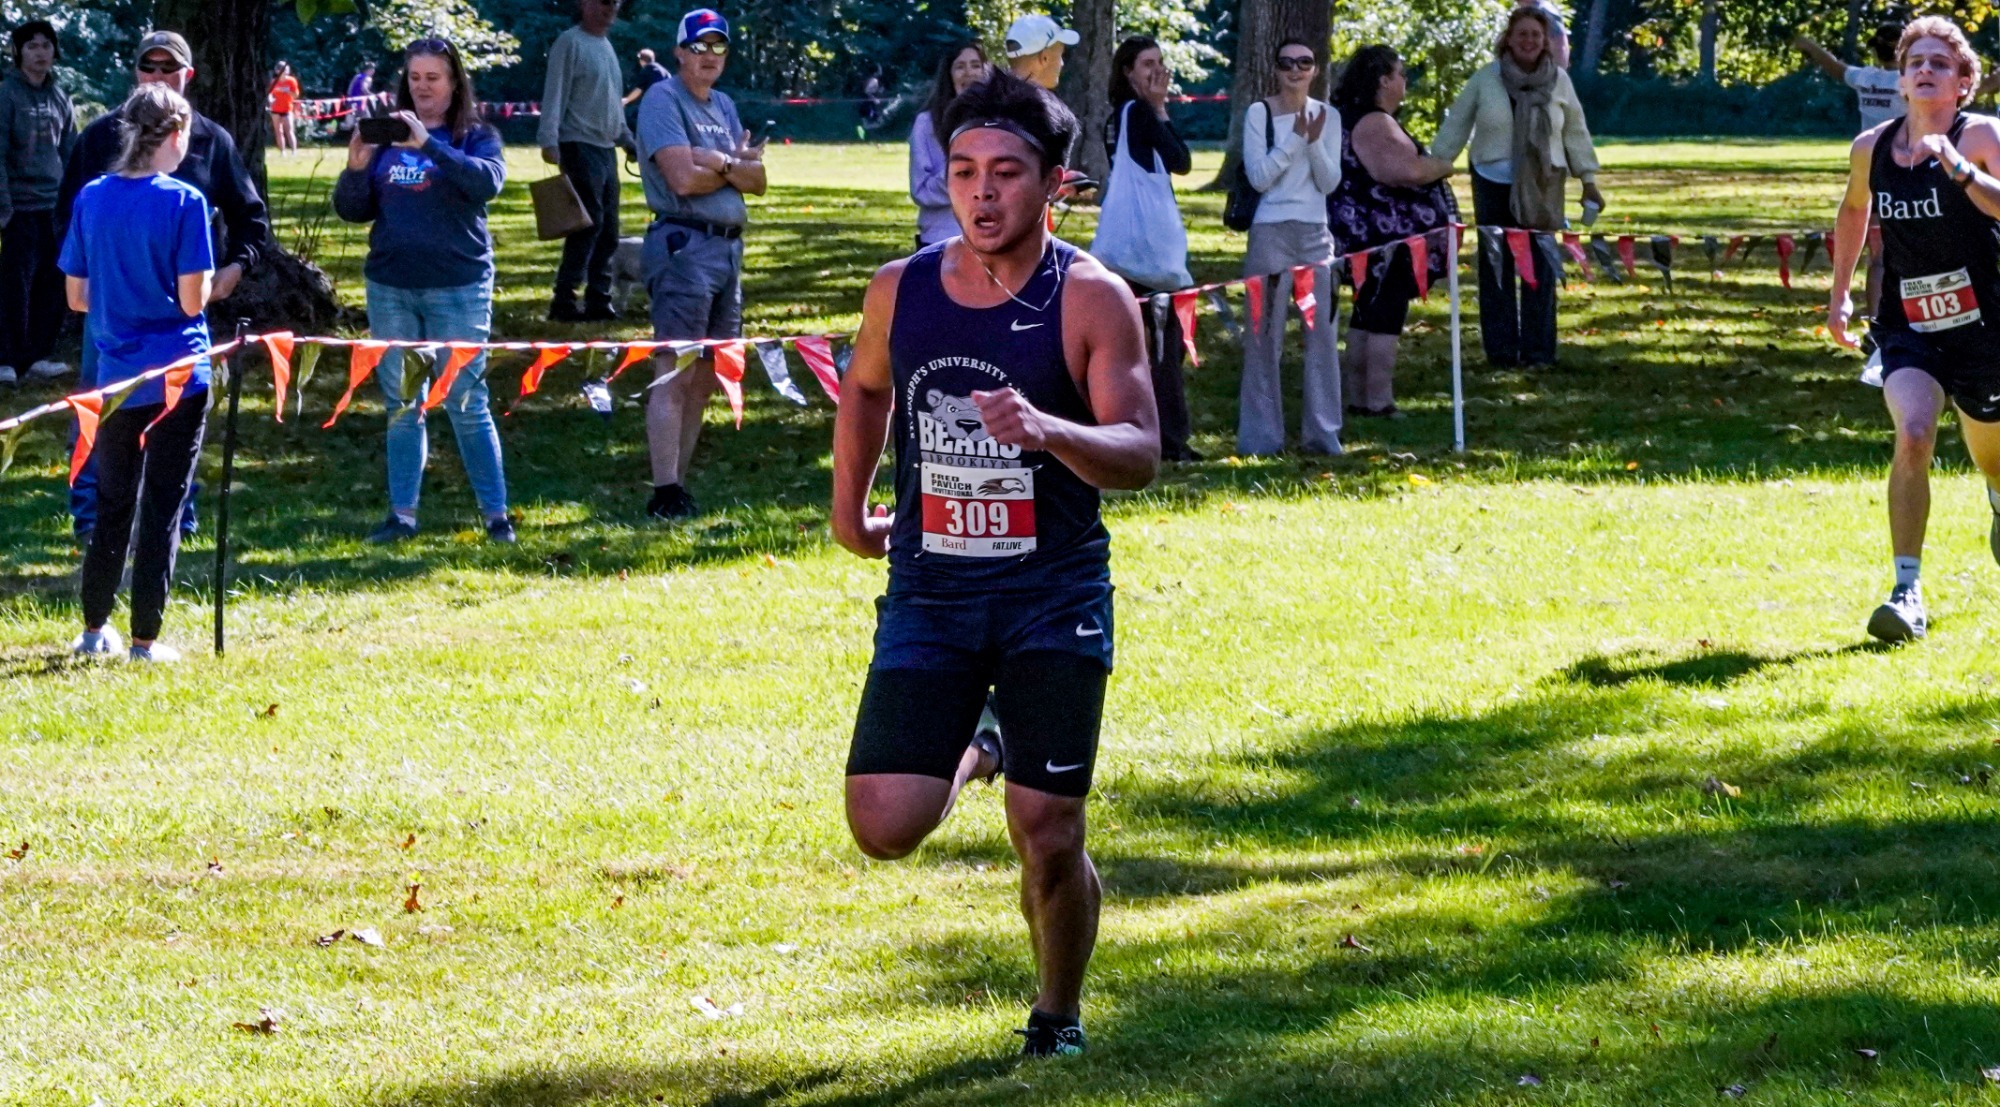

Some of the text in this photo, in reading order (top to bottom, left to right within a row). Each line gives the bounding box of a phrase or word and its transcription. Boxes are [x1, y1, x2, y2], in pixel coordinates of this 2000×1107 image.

[1877, 188, 1943, 220] Bard
[1917, 292, 1961, 320] 103
[928, 356, 1008, 382] UNIVERSITY
[931, 472, 960, 482] FRED
[931, 478, 972, 491] PAVLICH
[931, 486, 974, 497] INVITATIONAL
[945, 500, 1009, 536] 309
[941, 537, 967, 550] Bard
[992, 541, 1022, 551] FAT.LIVE
